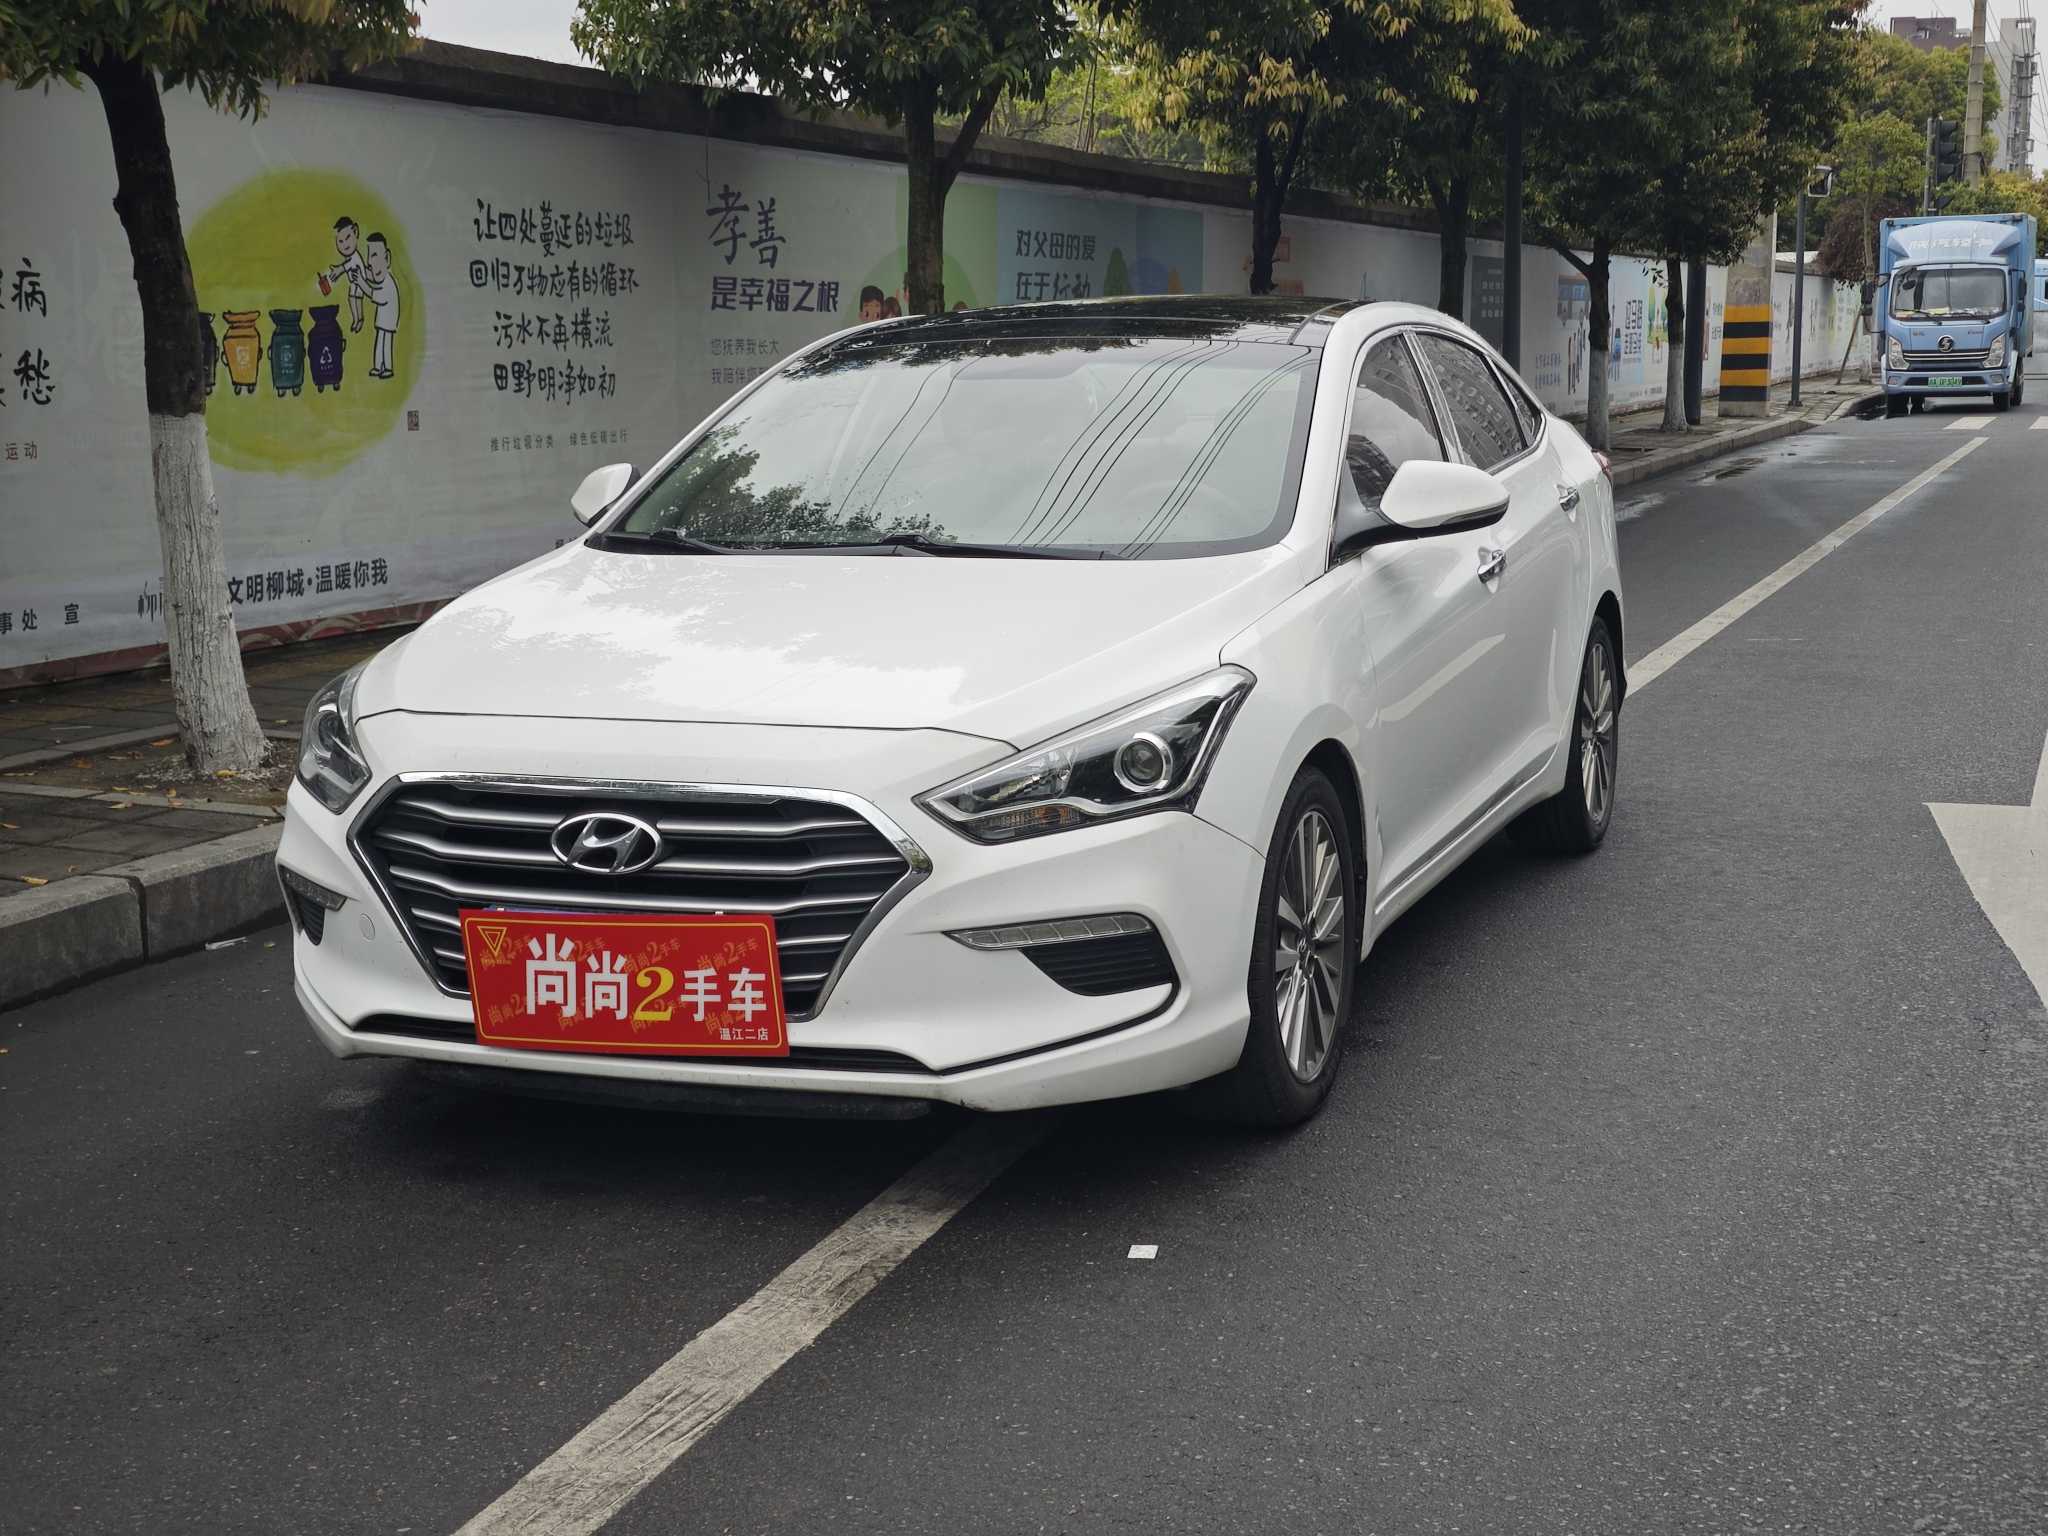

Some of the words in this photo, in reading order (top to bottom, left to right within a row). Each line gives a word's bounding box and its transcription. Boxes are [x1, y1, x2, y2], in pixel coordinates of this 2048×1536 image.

[474, 198, 634, 257] 让四处蔓延的垃圾
[705, 185, 787, 269] 孝善
[1016, 230, 1096, 261] 对父母的爱
[469, 257, 640, 300] 回归万物应有的循环
[711, 276, 840, 312] 是幸福之根
[493, 303, 614, 351] 污水不再横流
[493, 354, 616, 406] 田野明净如初
[5, 441, 38, 460] 运动
[64, 602, 80, 625] 宣
[525, 933, 768, 1022] 尚尚2手车
[719, 1027, 769, 1041] 温江二店
